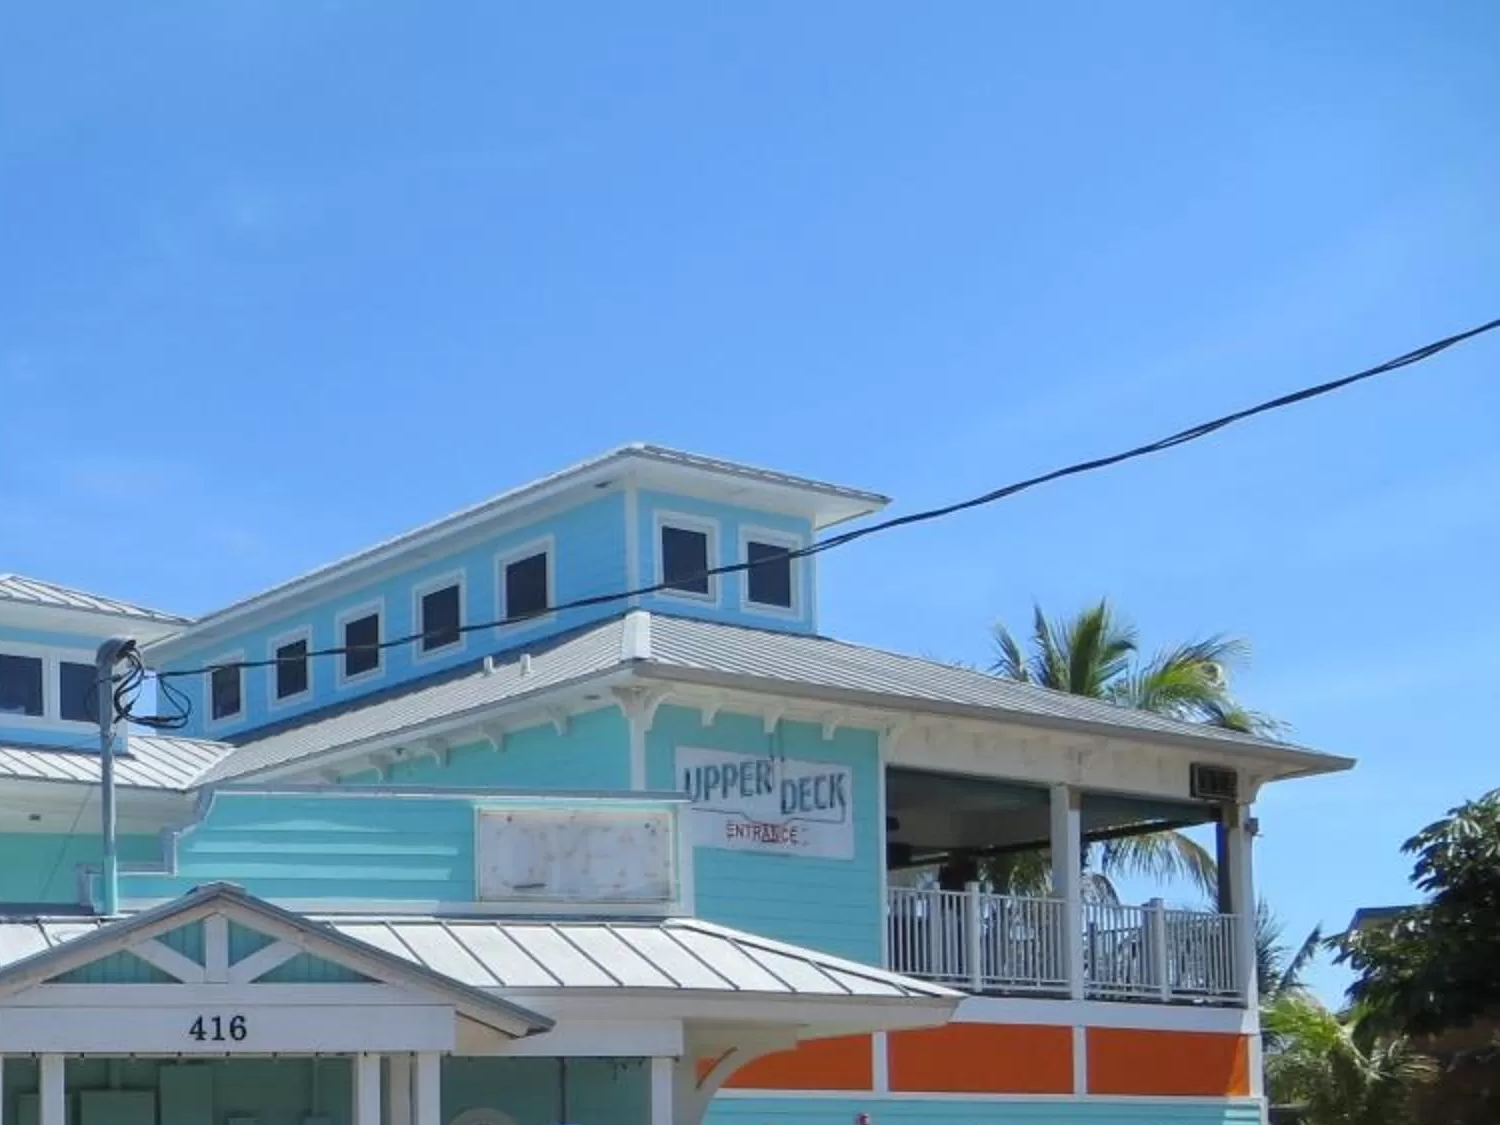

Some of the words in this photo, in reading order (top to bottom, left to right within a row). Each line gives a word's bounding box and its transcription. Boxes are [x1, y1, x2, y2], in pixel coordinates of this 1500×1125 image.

[684, 759, 773, 802] UPPER
[780, 772, 846, 815] DECK
[188, 1014, 248, 1041] 416
